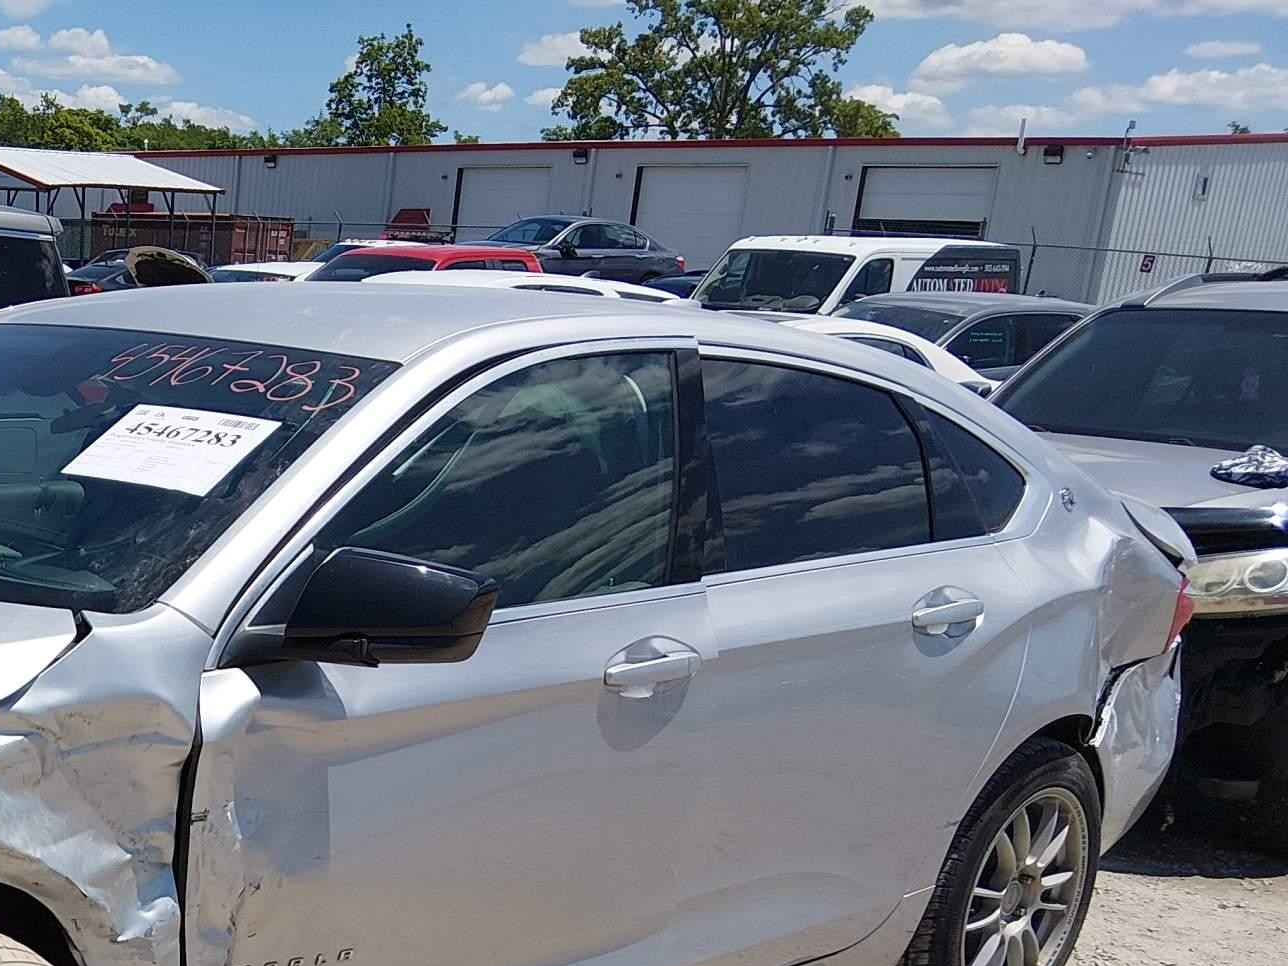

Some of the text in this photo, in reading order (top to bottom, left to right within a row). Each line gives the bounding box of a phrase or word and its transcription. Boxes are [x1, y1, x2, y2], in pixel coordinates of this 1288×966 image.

[1141, 256, 1154, 271] 5
[912, 278, 974, 293] AUTOMATED
[98, 342, 361, 411] 45467283
[125, 421, 242, 448] 45467283
